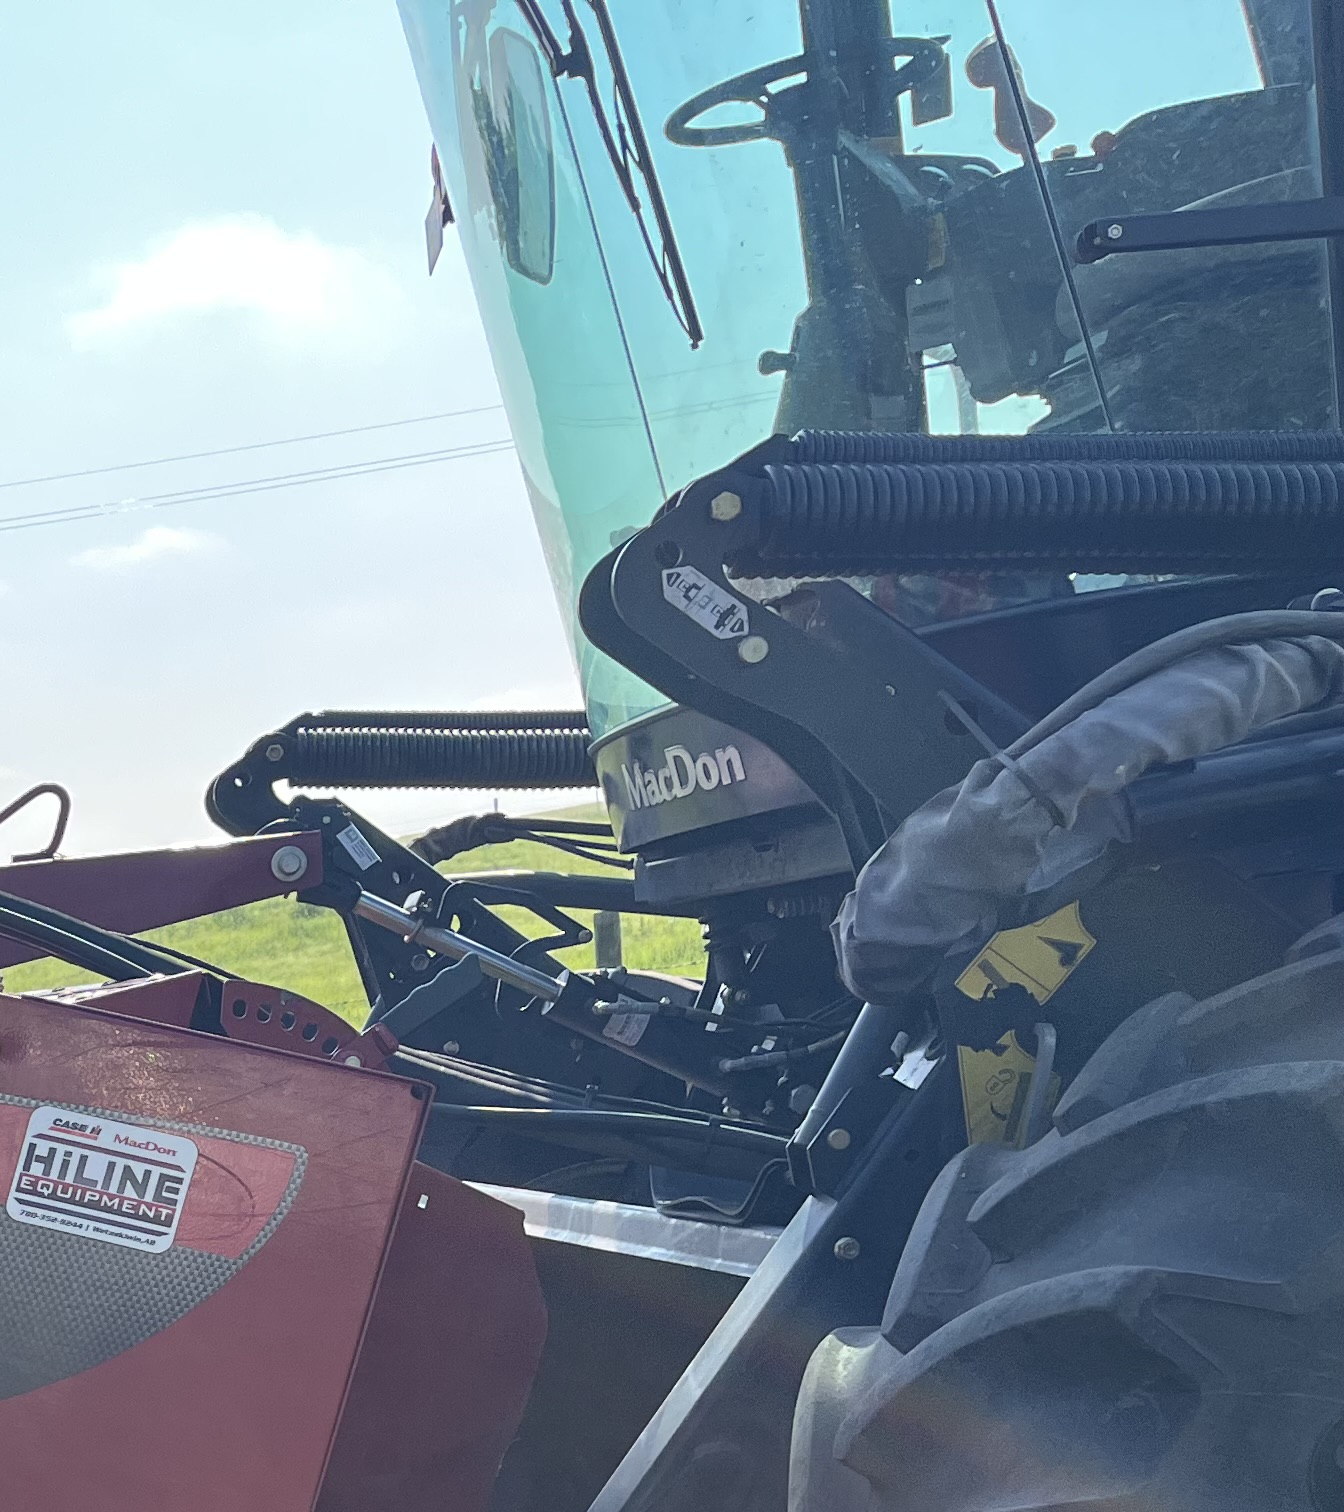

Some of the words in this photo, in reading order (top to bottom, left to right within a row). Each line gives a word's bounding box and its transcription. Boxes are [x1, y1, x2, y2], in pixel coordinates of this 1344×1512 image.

[621, 745, 746, 811] MacDon
[52, 1118, 89, 1133] CASE
[113, 1133, 178, 1157] MacDon
[22, 1142, 184, 1207] HiLINE
[19, 1177, 173, 1221] EQUIPMENT
